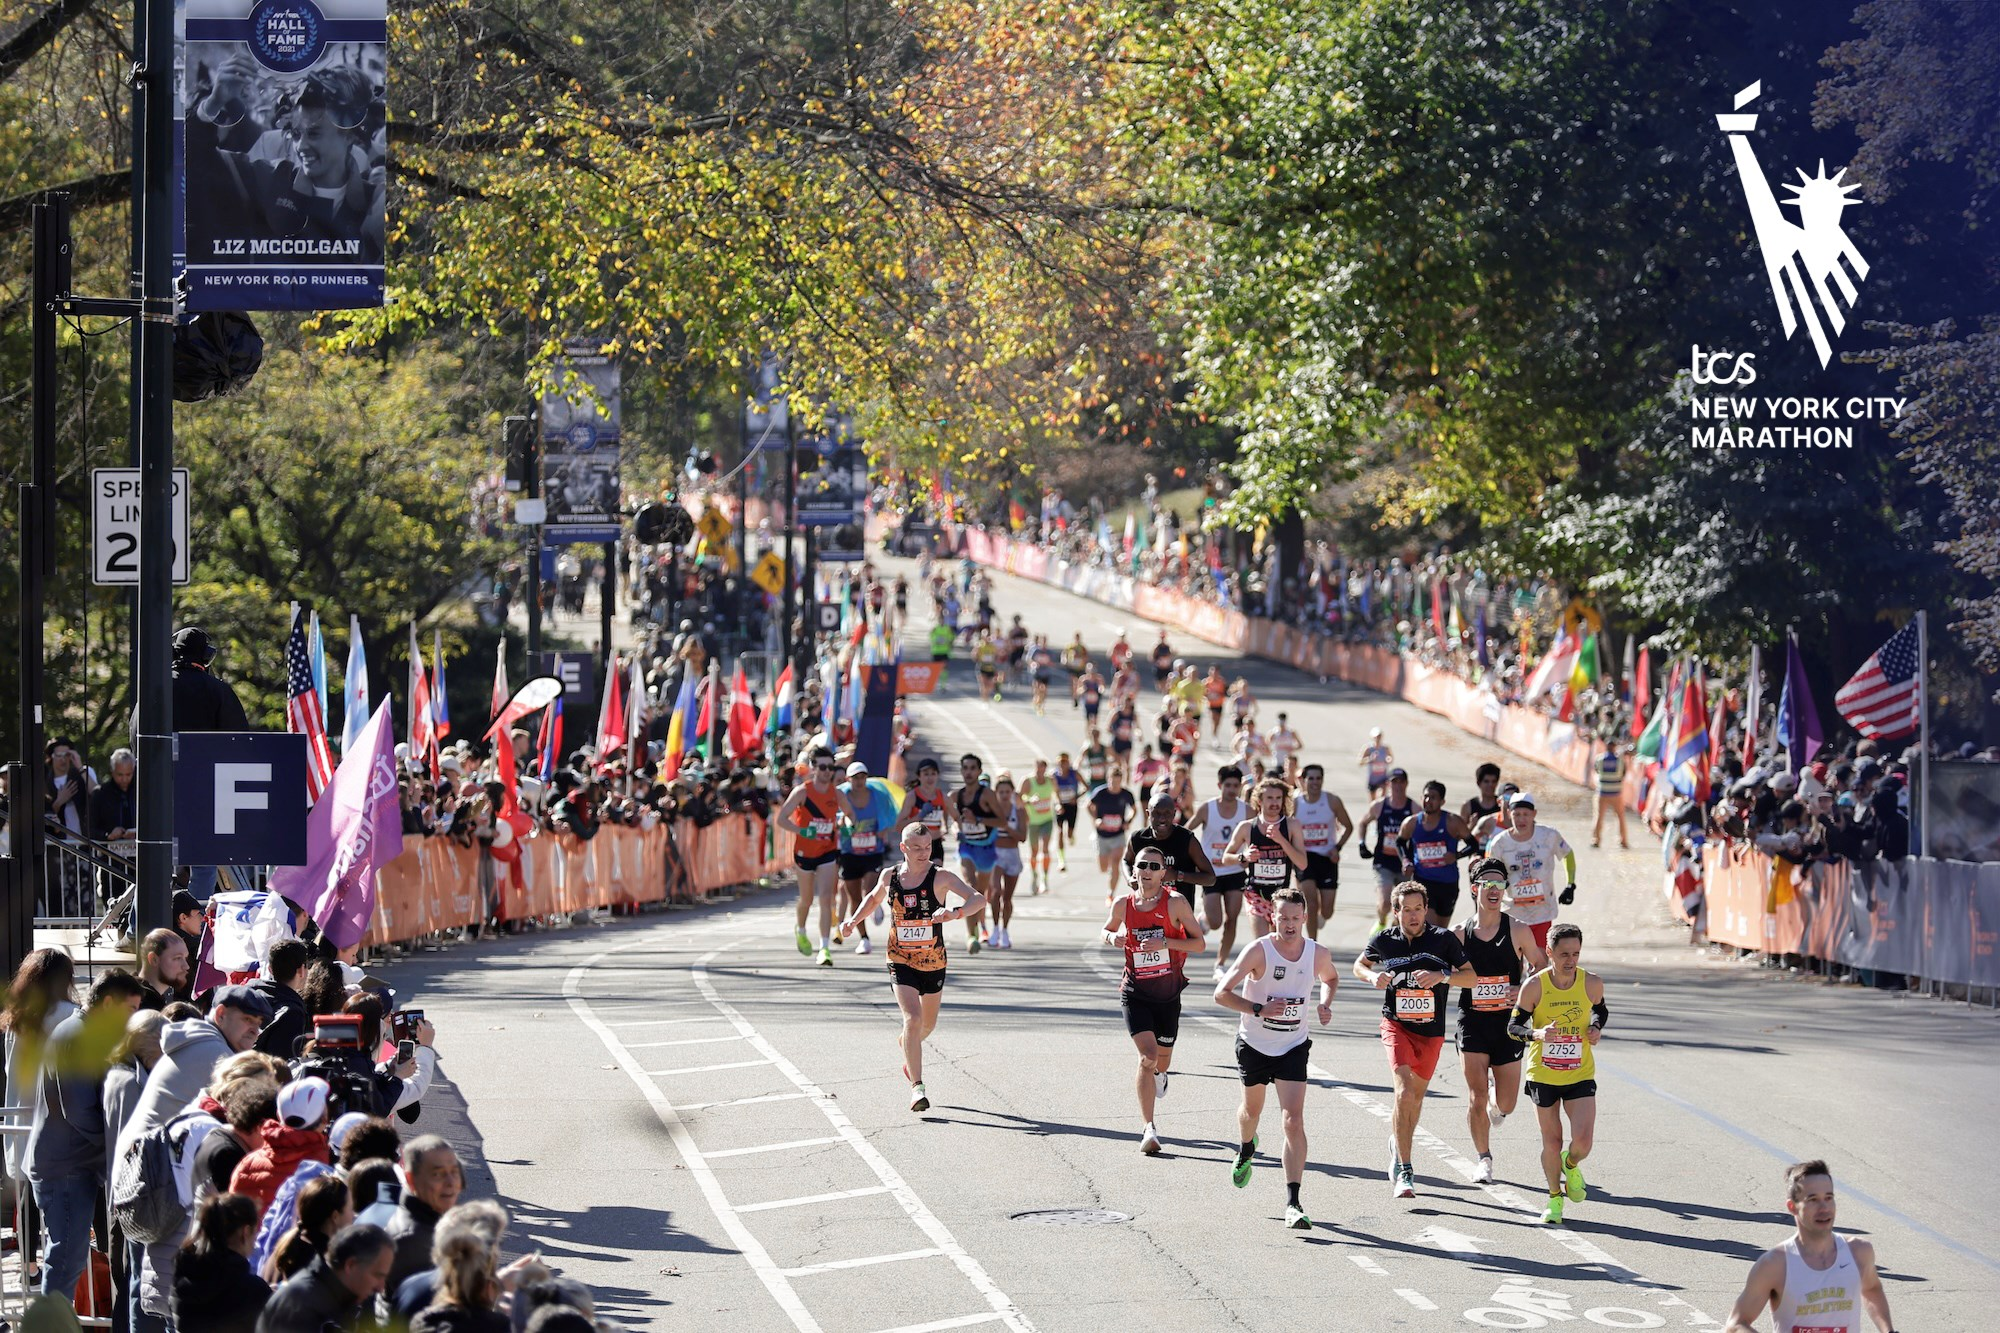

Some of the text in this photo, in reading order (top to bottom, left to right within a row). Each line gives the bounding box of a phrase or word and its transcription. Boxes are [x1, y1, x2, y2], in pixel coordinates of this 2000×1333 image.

[268, 20, 305, 30] HALL
[268, 35, 305, 45] FAME
[213, 239, 361, 255] LIZ MCCOLGAN
[204, 275, 369, 285] NEW YORK ROAD RUNNERS
[214, 763, 272, 834] F
[1260, 865, 1281, 874] 1455
[1516, 885, 1538, 896] 2421
[903, 927, 926, 938] 2147
[1141, 951, 1161, 964] 746
[1477, 984, 1505, 996] 2332
[1401, 998, 1430, 1009] 2005
[1548, 1044, 1576, 1055] 2752
